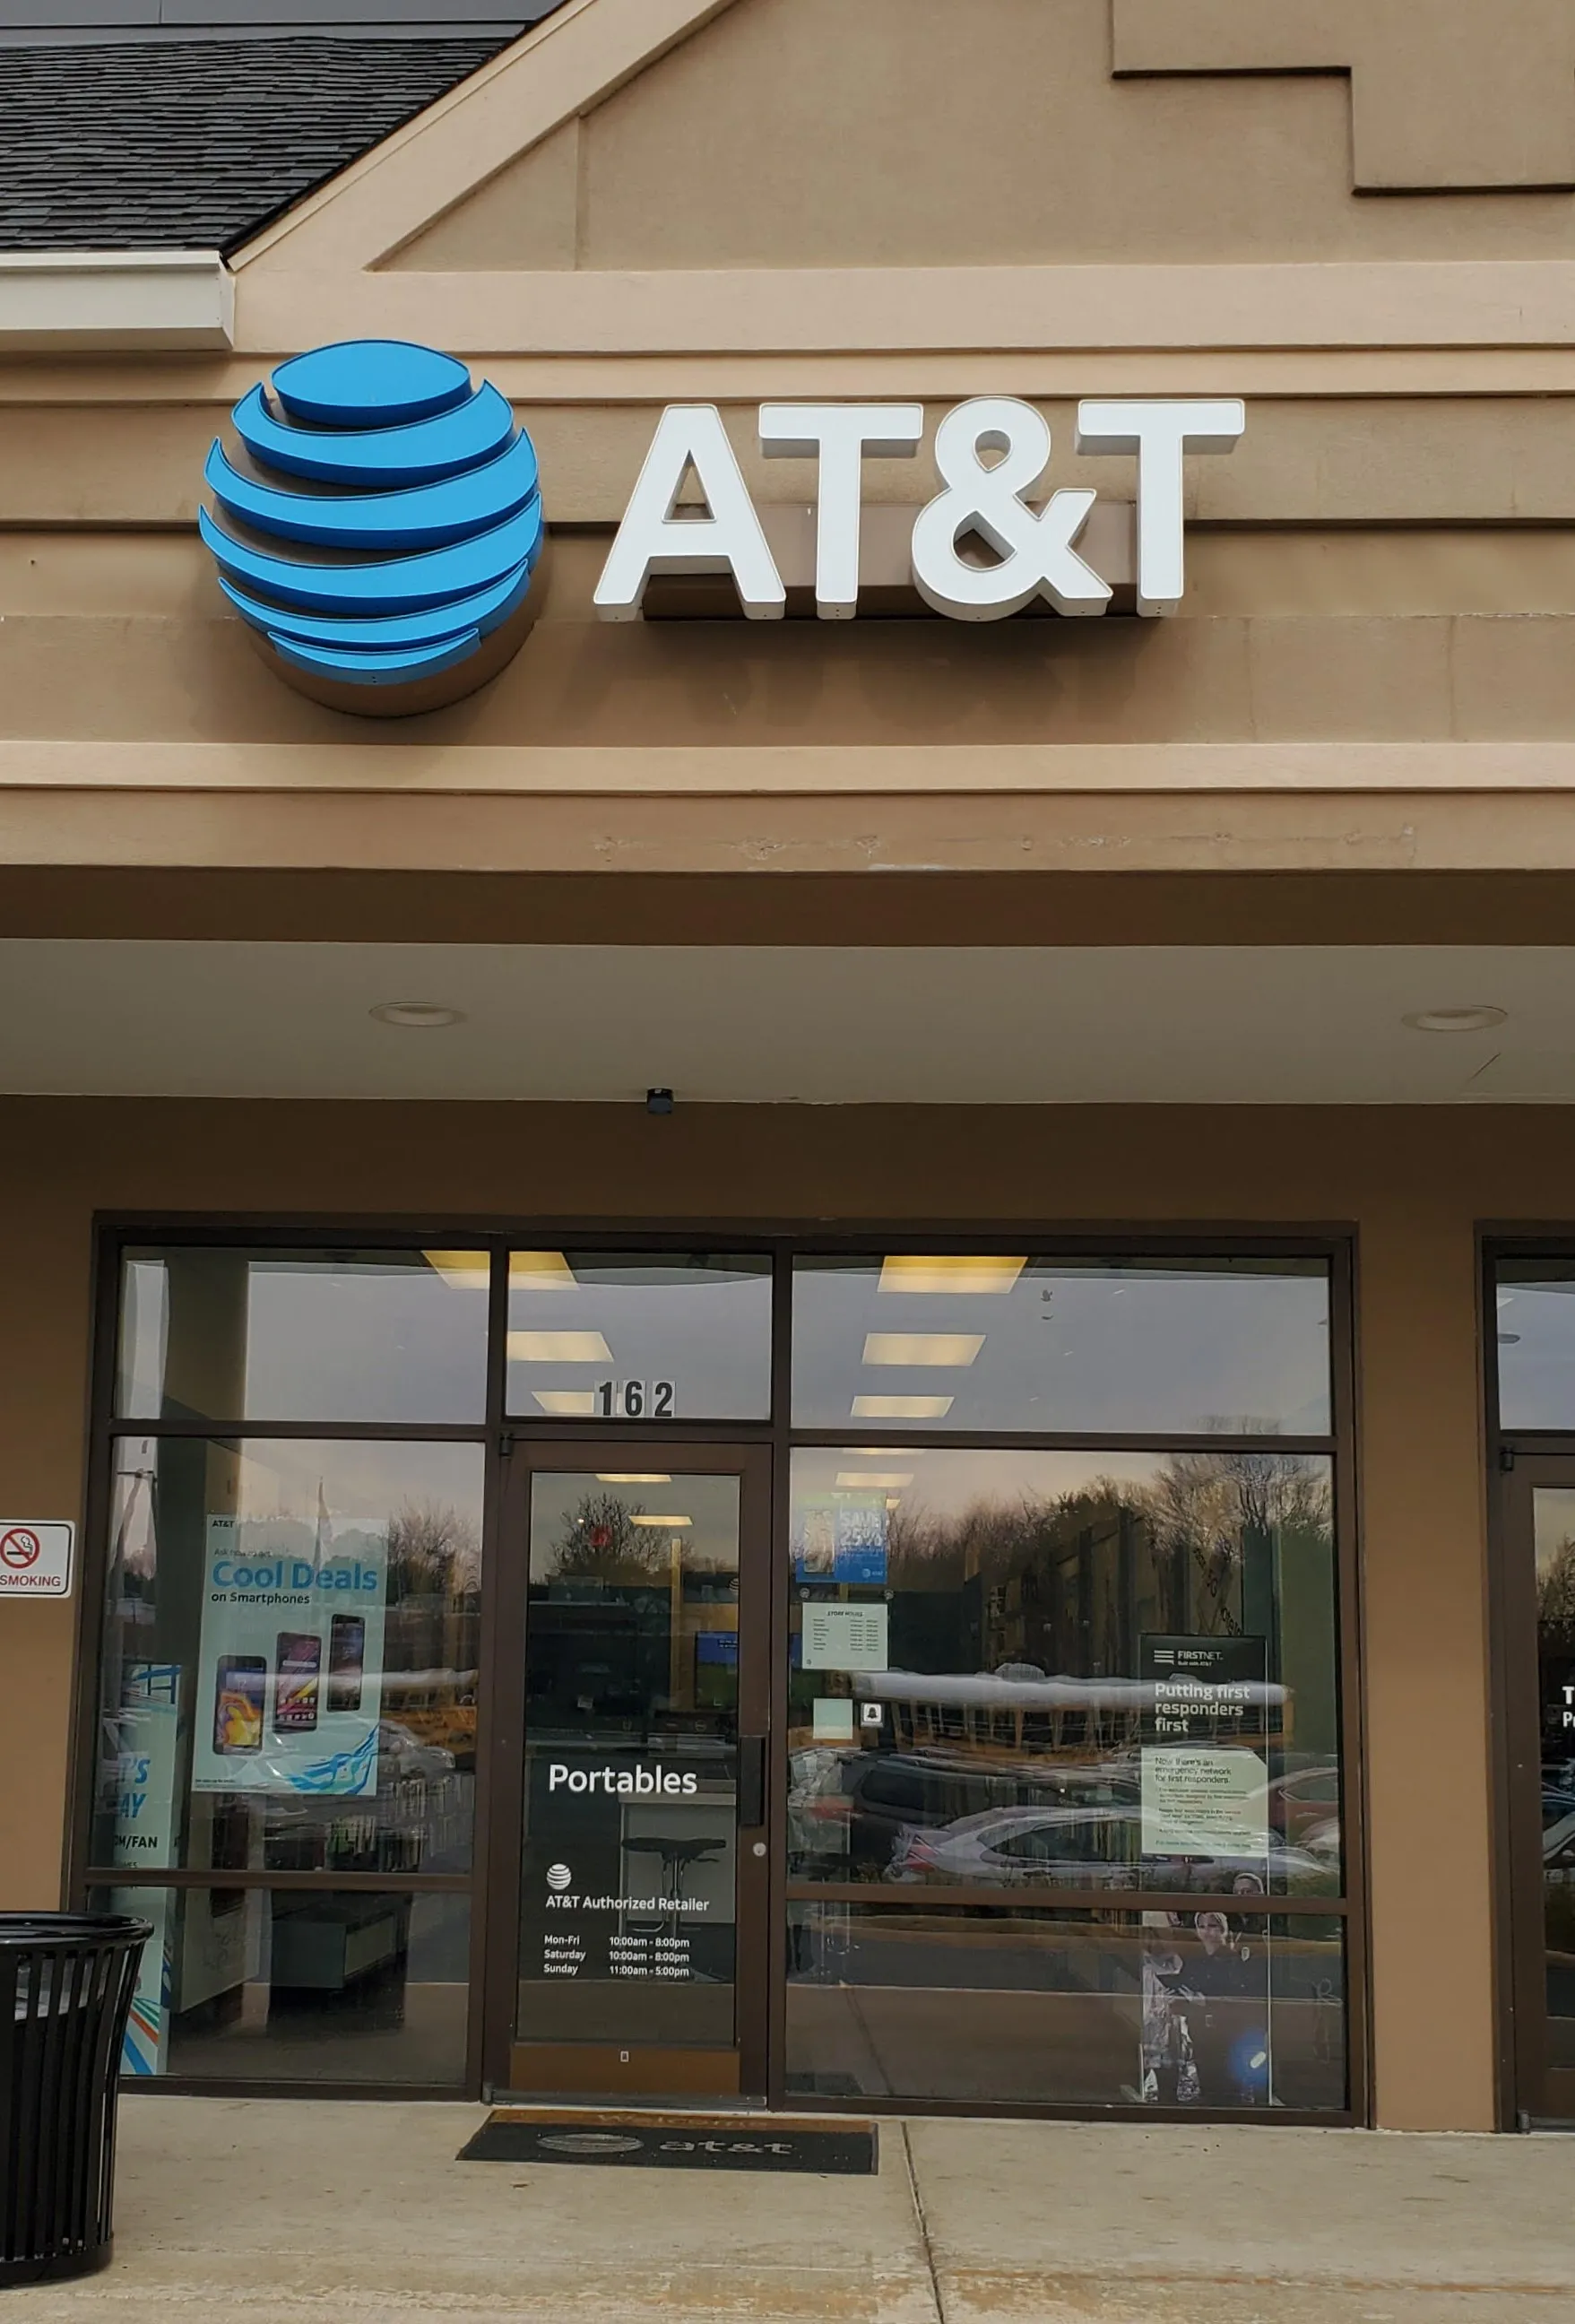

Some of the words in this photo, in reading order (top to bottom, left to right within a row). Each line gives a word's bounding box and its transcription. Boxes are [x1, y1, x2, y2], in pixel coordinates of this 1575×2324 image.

[593, 395, 1245, 620] AT&T
[599, 1381, 673, 1418] 162
[212, 1520, 235, 1528] AT&T
[840, 1527, 883, 1547] 25%
[0, 1574, 61, 1587] SMOKING
[212, 1560, 283, 1589] Cool
[291, 1563, 377, 1591] Deals
[211, 1592, 227, 1602] on
[229, 1592, 310, 1606] Smartphones
[1155, 1683, 1214, 1701] Putting
[1216, 1684, 1250, 1700] first
[1155, 1702, 1244, 1718] responders
[1155, 1717, 1190, 1732] first
[549, 1764, 698, 1794] Portables
[545, 1895, 581, 1909] AT&T
[583, 1895, 656, 1911] Authorized
[658, 1896, 710, 1912] Retailer
[543, 1934, 581, 1946] Mon-Fri
[609, 1936, 648, 1947] 10:00am
[654, 1937, 690, 1949] 8:00pm
[543, 1948, 587, 1962] Saturday
[609, 1950, 648, 1962] 10:00am
[654, 1952, 690, 1964] 8:00pm
[542, 1963, 580, 1976] Sunday
[609, 1964, 648, 1976] 11:00am
[654, 1966, 690, 1980] 5:00pm
[658, 2139, 794, 2155] at&t
